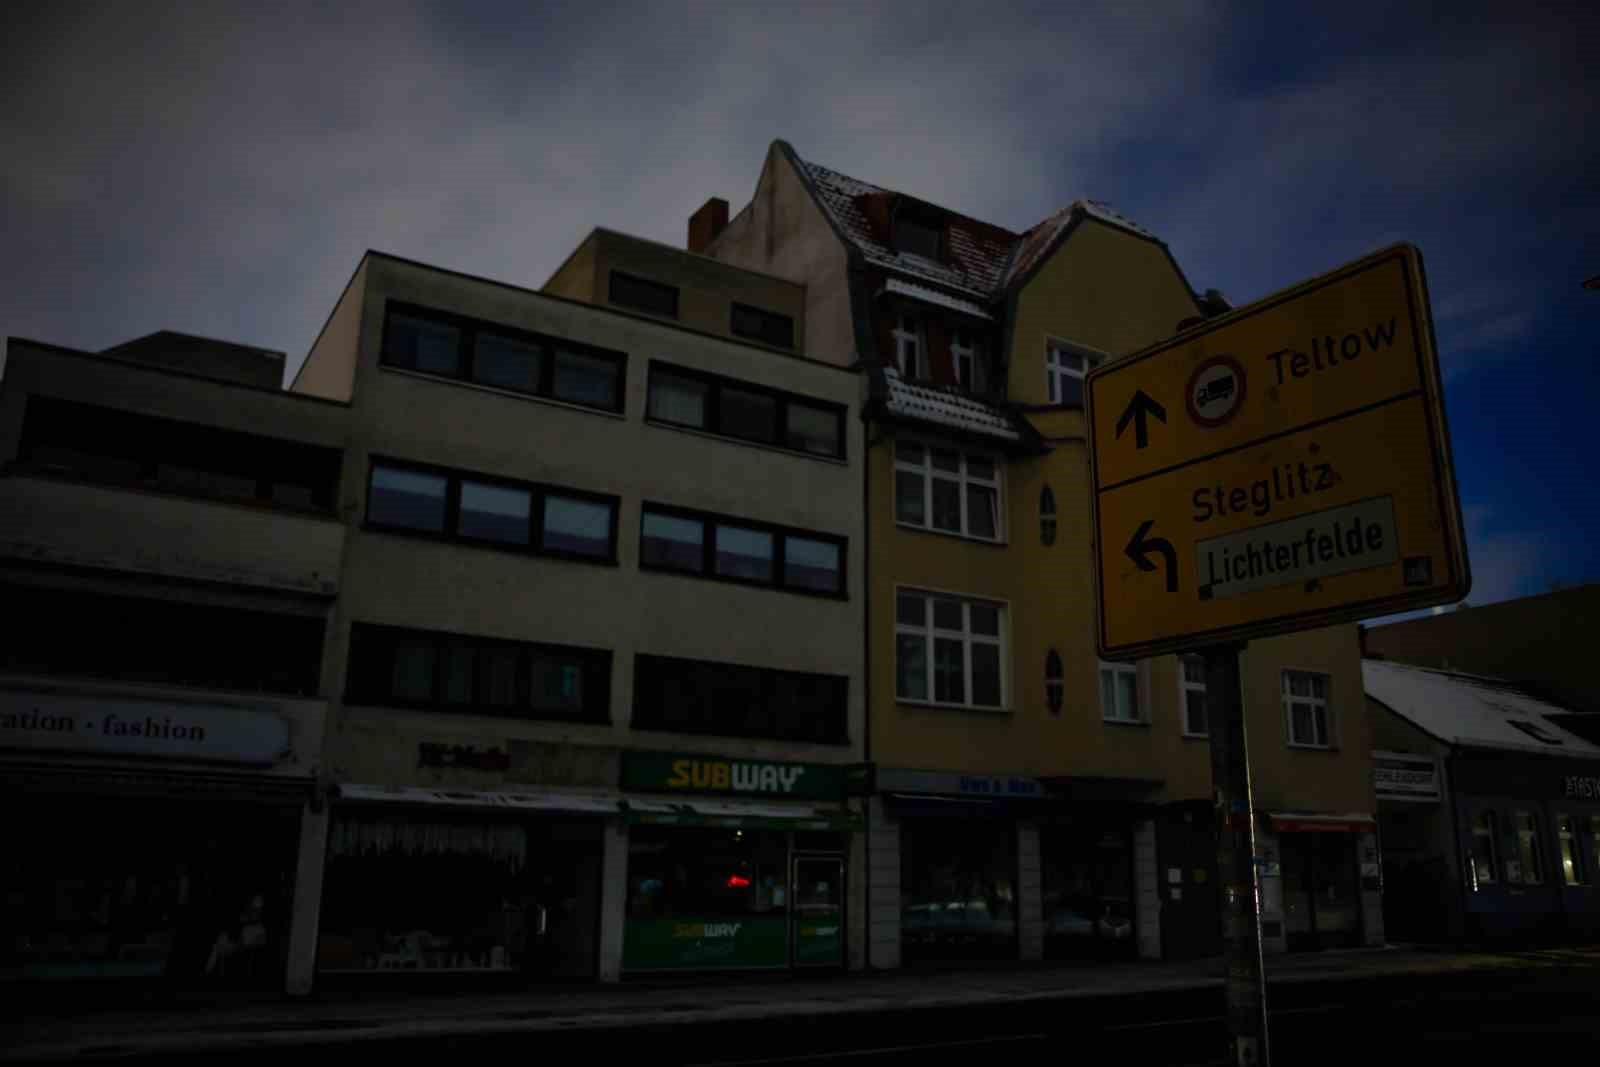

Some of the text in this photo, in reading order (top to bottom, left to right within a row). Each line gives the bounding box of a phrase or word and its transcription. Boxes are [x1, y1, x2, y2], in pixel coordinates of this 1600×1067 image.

[1266, 316, 1397, 385] Teltow
[1193, 462, 1336, 523] Steglitz
[1207, 517, 1383, 586] Lichterfelde
[103, 713, 206, 741] fashion
[665, 759, 805, 793] SUBWAY
